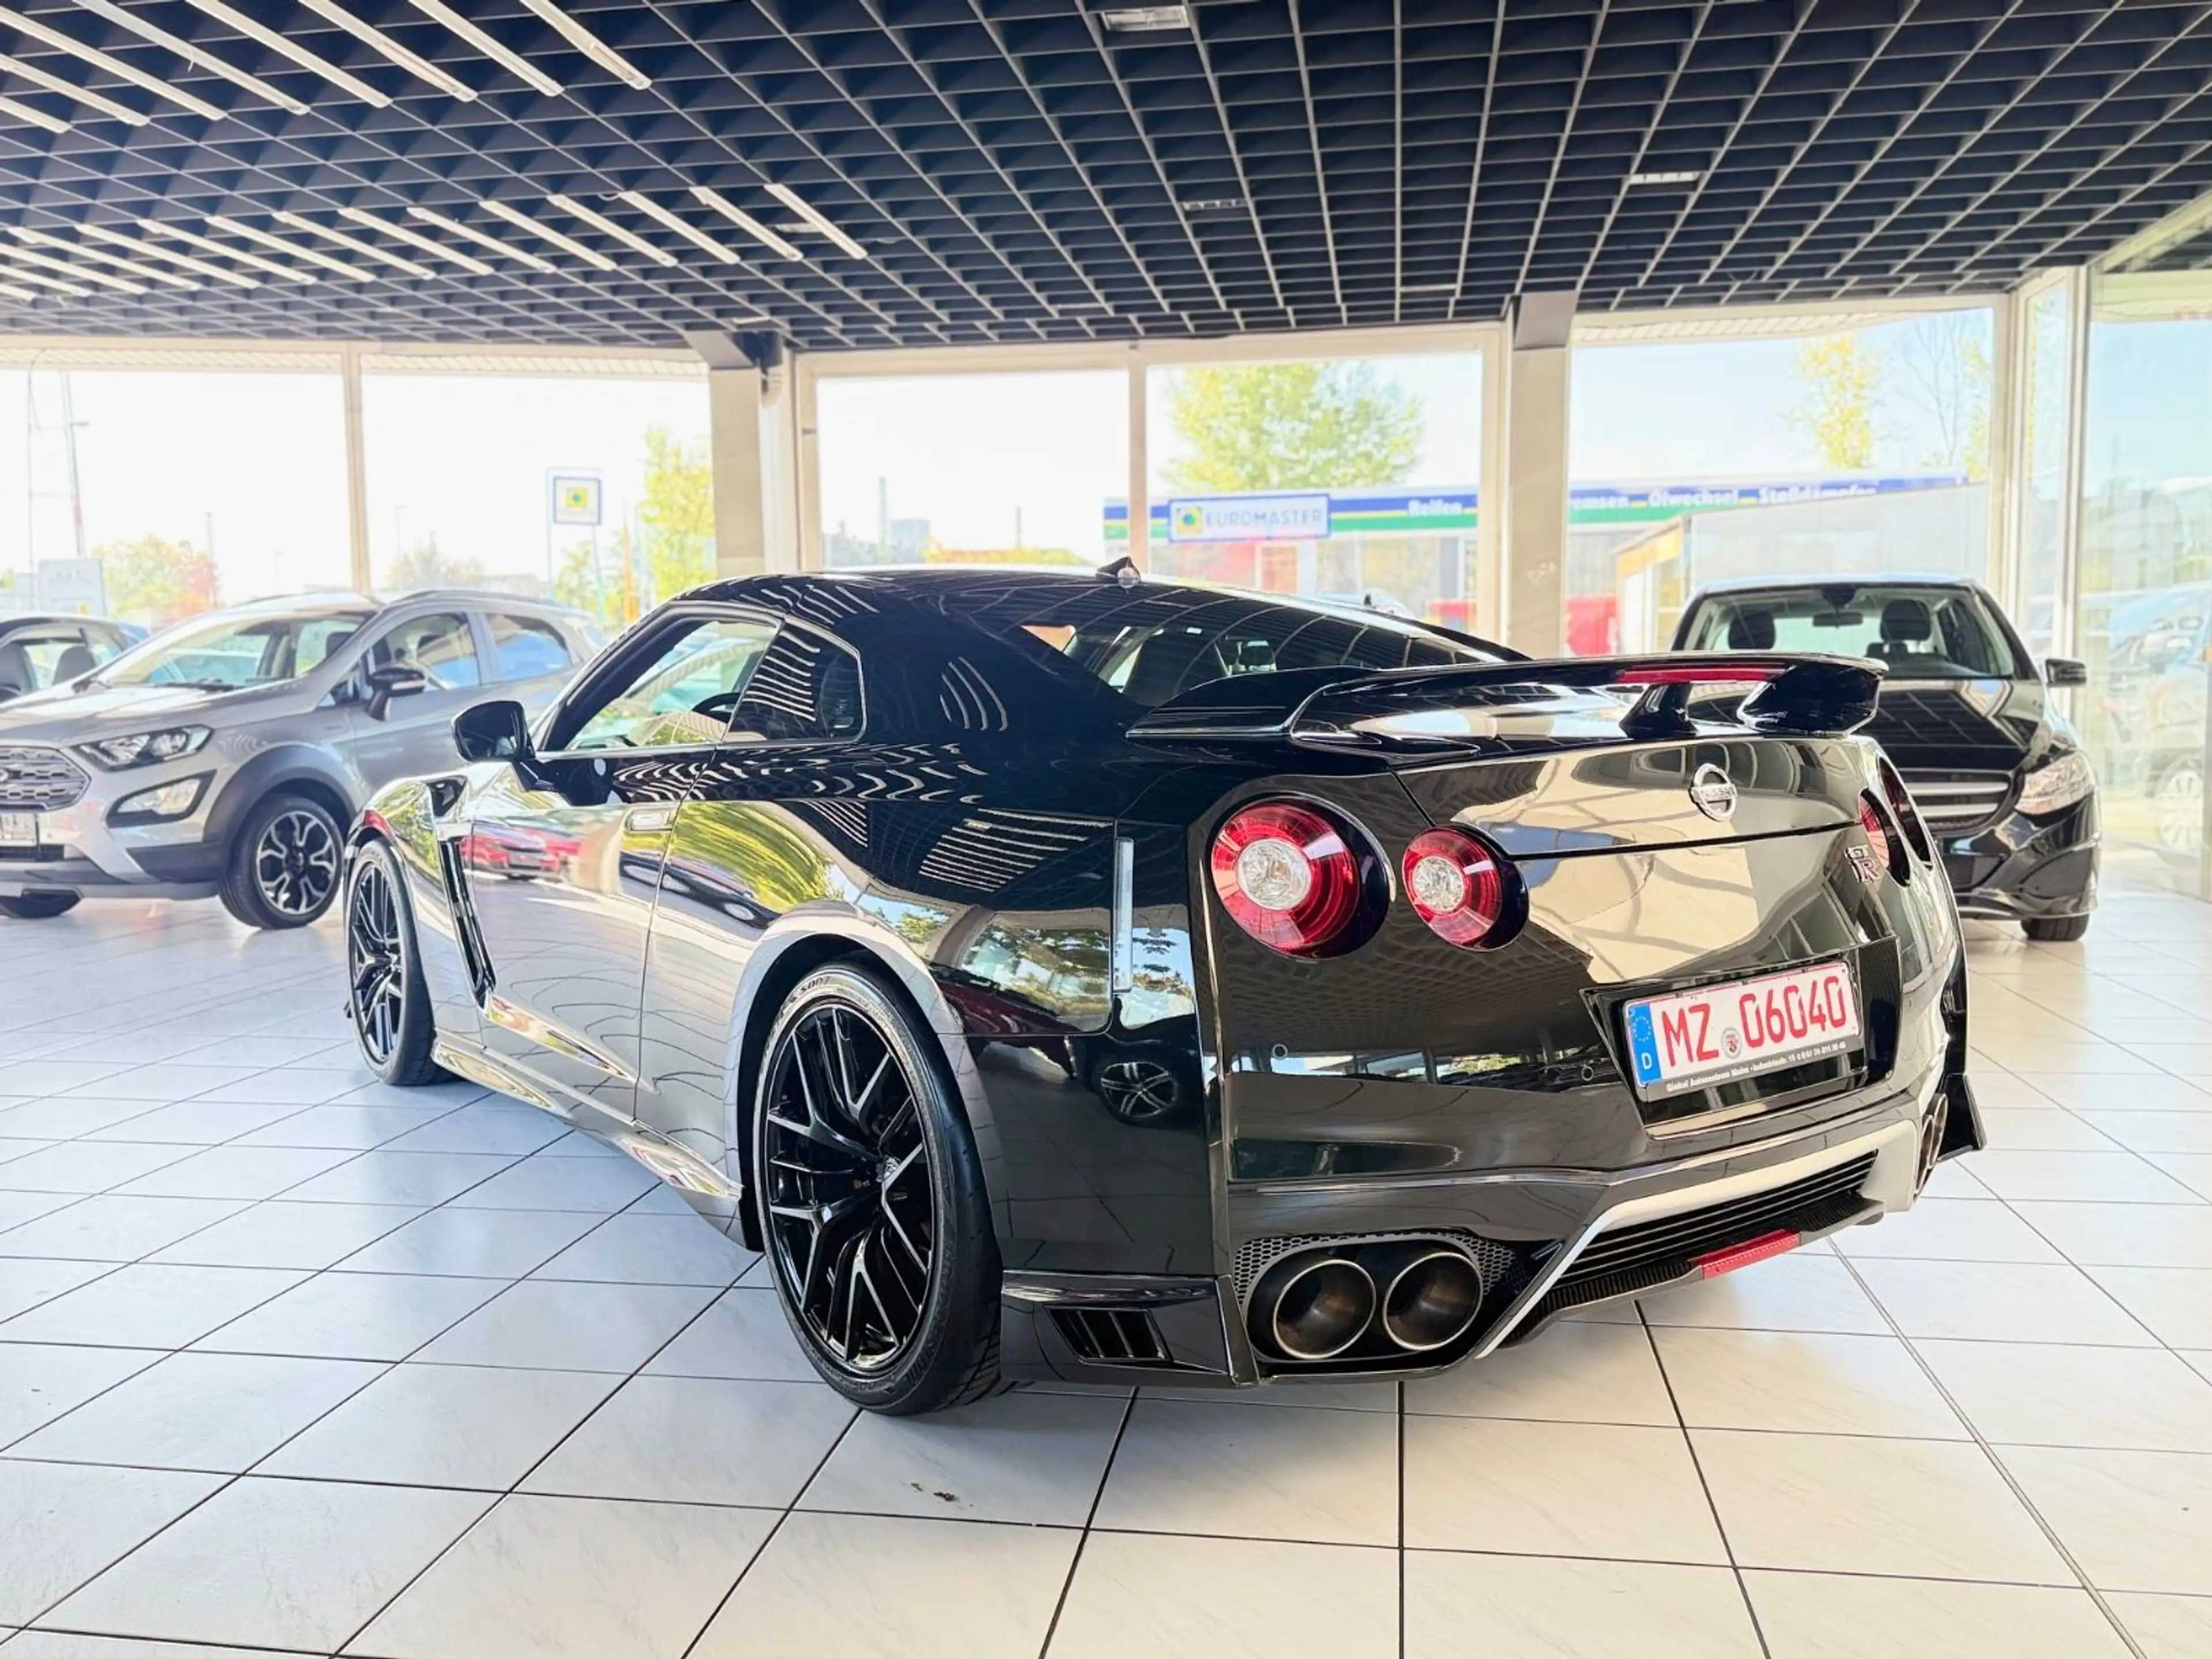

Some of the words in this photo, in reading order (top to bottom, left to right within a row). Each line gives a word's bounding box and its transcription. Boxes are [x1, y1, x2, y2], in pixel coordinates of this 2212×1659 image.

[1408, 498, 1463, 517] Reifen
[1205, 508, 1323, 528] EUROMASTER
[1641, 1052, 1652, 1070] D
[1662, 1003, 1719, 1067] MZ
[1739, 976, 1846, 1048] 06040
